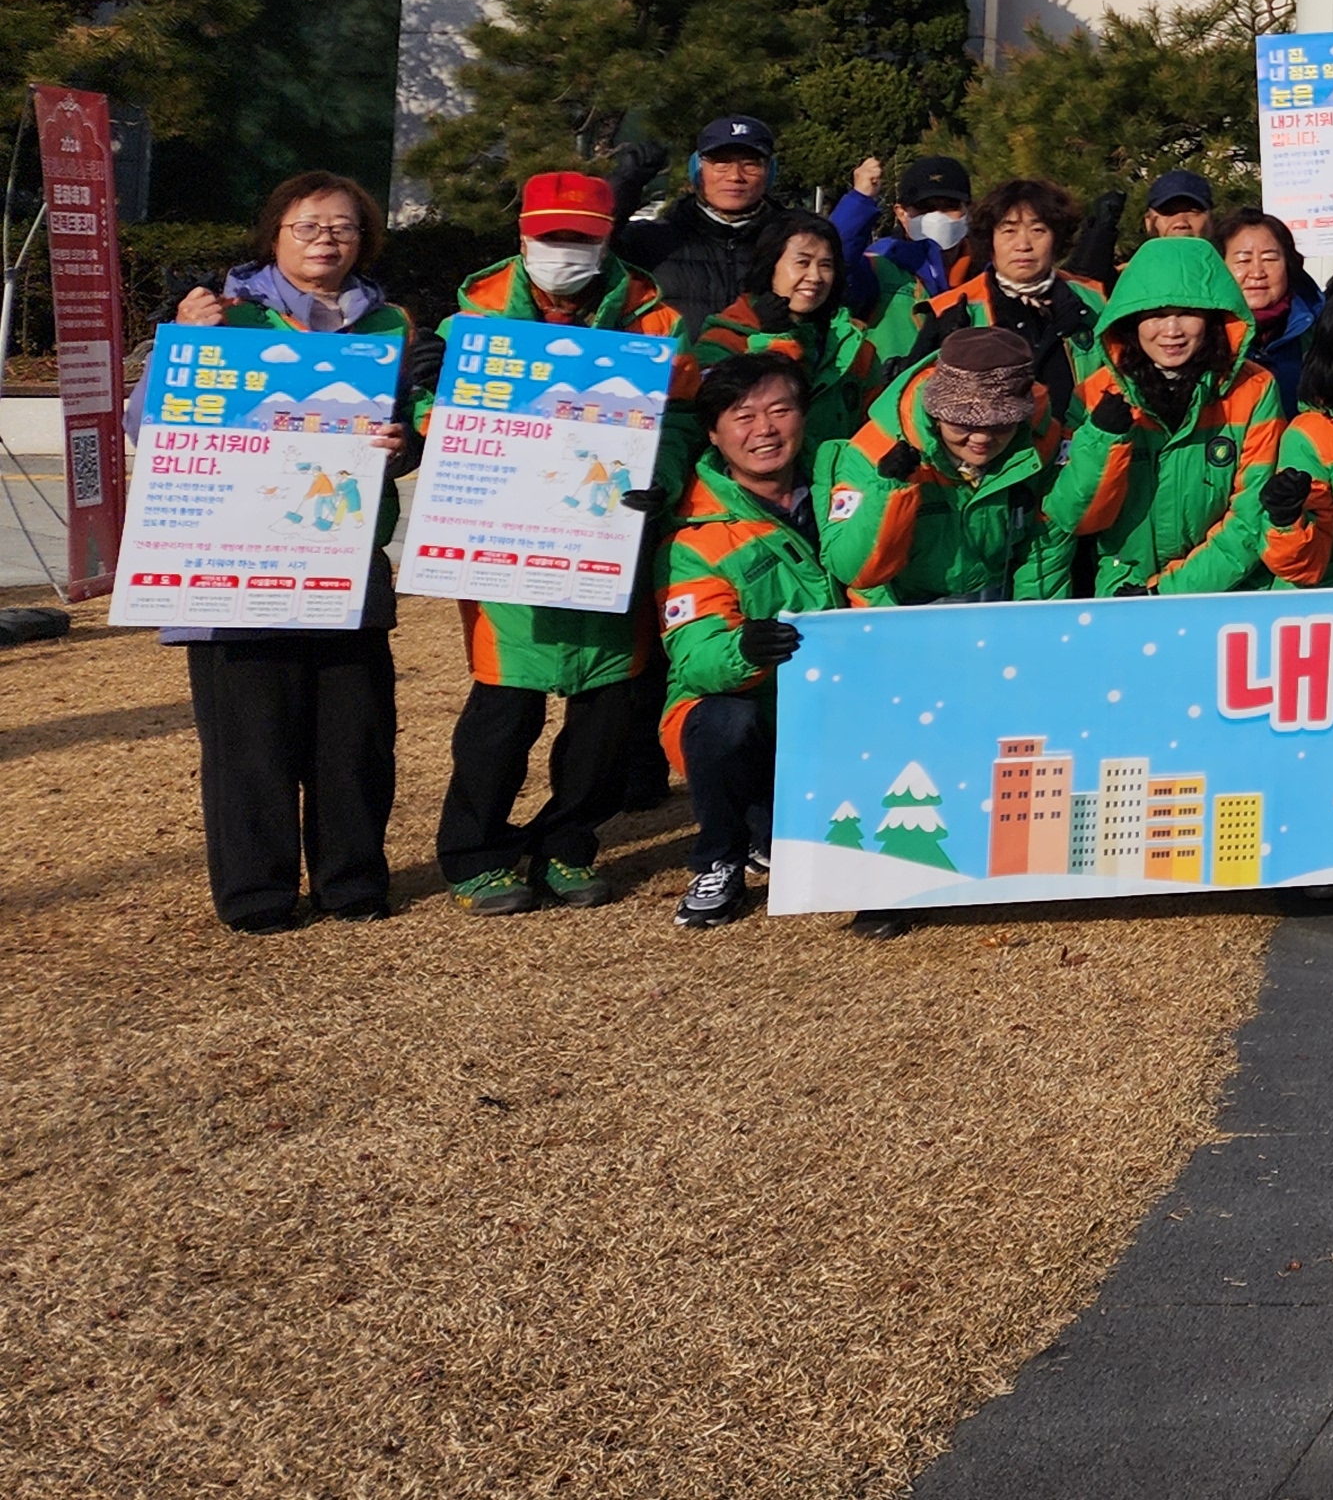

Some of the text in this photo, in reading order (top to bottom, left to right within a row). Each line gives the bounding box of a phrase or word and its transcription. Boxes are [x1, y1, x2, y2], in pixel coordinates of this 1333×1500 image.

[1269, 47, 1307, 64] 내 집,
[1269, 66, 1285, 82] 내
[1288, 64, 1318, 81] 점포
[1270, 84, 1313, 108] 눈은
[1271, 113, 1300, 129] 내가
[169, 342, 228, 367] 내 집,
[462, 331, 516, 356] 내 집,
[165, 366, 268, 391] 내 점포 앞
[451, 377, 513, 409] 눈은
[159, 392, 226, 423] 눈은
[445, 412, 553, 441] 내가 치워야
[154, 431, 272, 454] 내가 치워야
[440, 434, 508, 458] 합니다.
[150, 454, 223, 476] 합니다.
